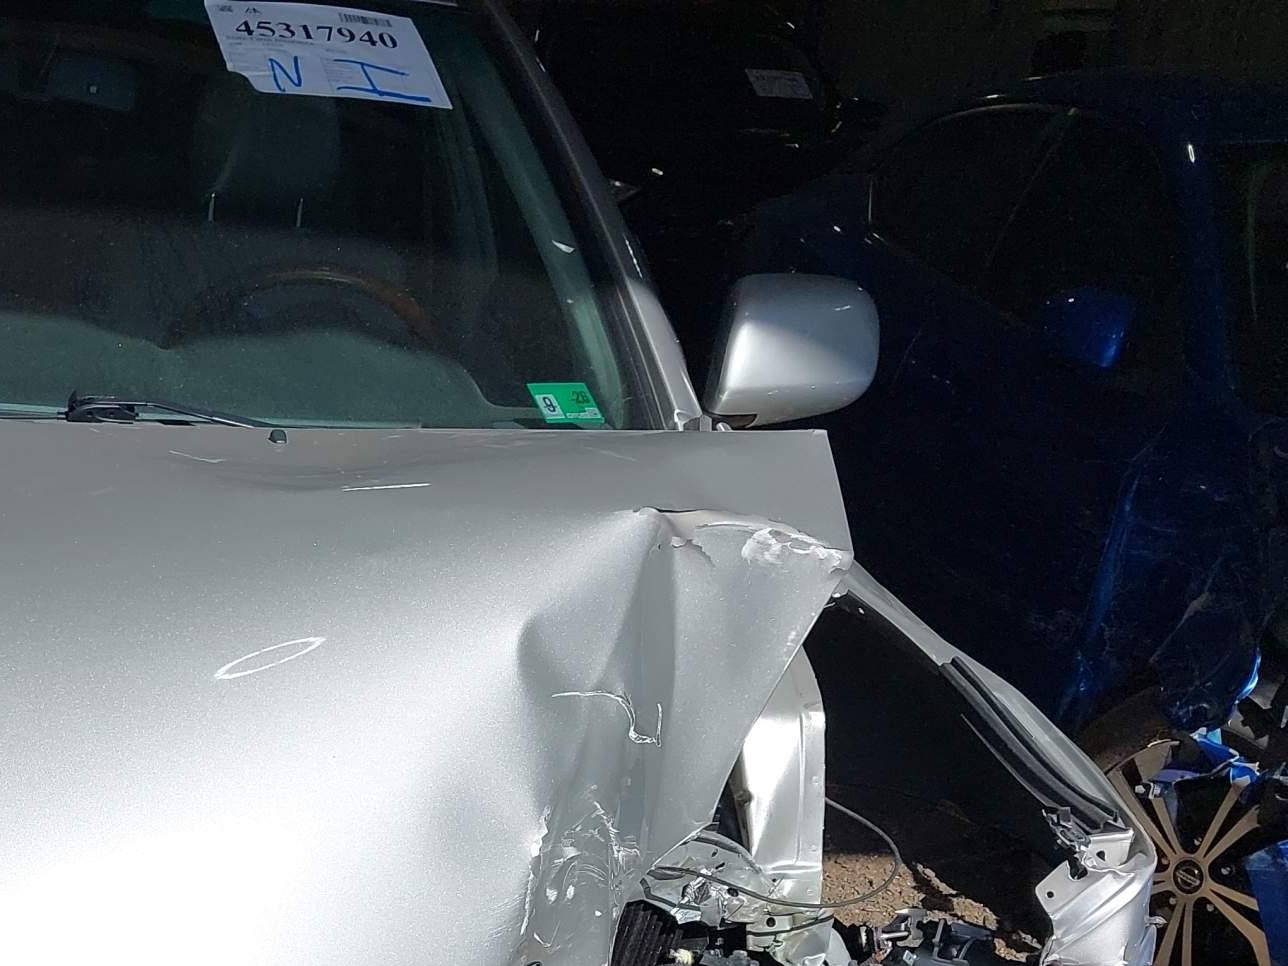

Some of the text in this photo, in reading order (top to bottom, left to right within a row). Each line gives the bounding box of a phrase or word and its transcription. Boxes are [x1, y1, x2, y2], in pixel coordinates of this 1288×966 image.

[236, 20, 398, 49] 45317940
[269, 55, 303, 92] N
[543, 397, 558, 412] 9
